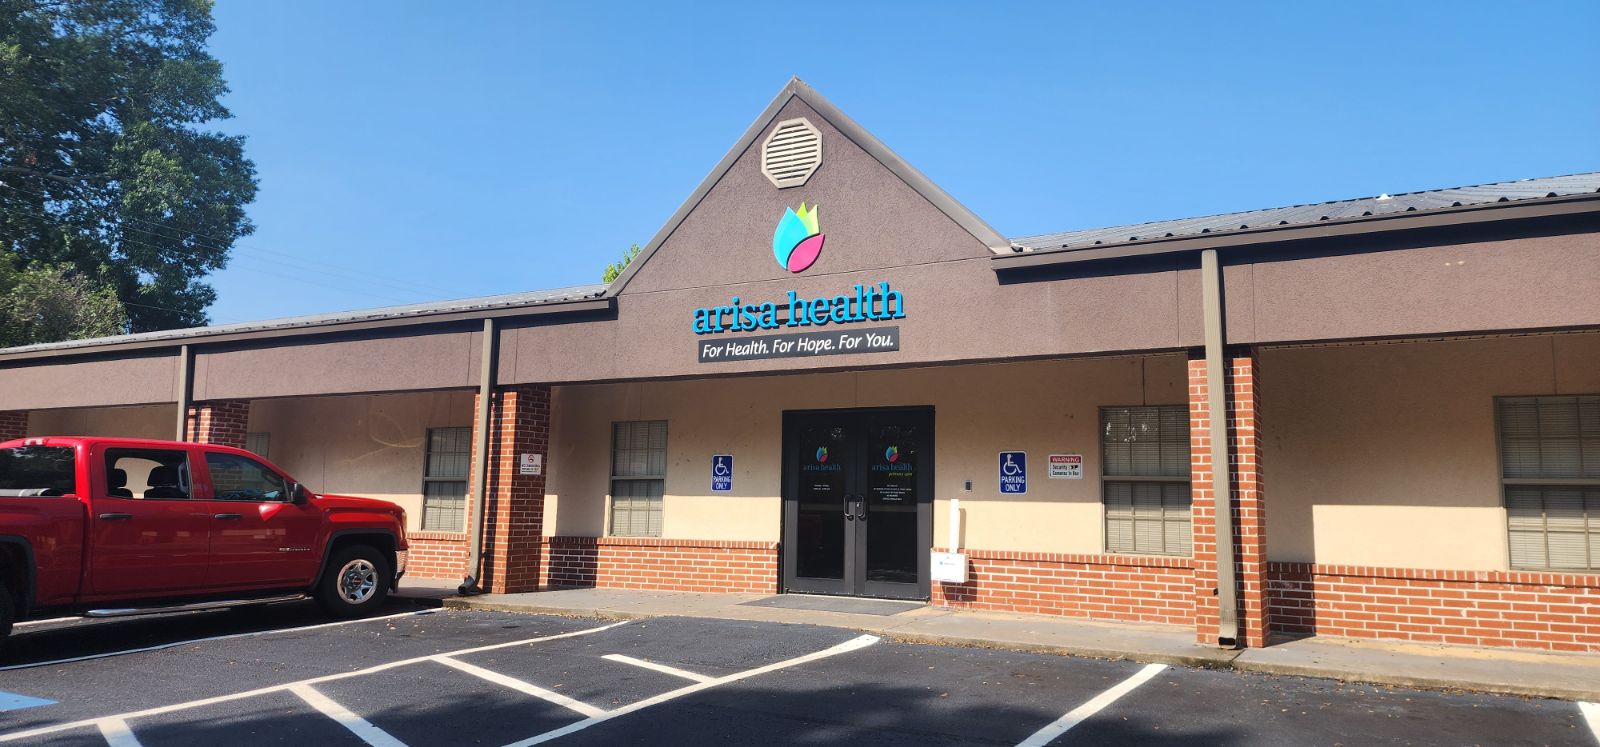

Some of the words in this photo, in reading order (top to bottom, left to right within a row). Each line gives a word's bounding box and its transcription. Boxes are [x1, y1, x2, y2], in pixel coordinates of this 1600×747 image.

[692, 296, 779, 334] arisa
[786, 280, 905, 327] health
[702, 344, 722, 358] For
[725, 339, 769, 356] Health.
[772, 339, 794, 354] For
[797, 335, 835, 354] Hope.
[838, 334, 863, 350] For
[865, 332, 894, 348] You.
[1001, 475, 1025, 483] PARKING
[1006, 484, 1021, 492] ONLY
